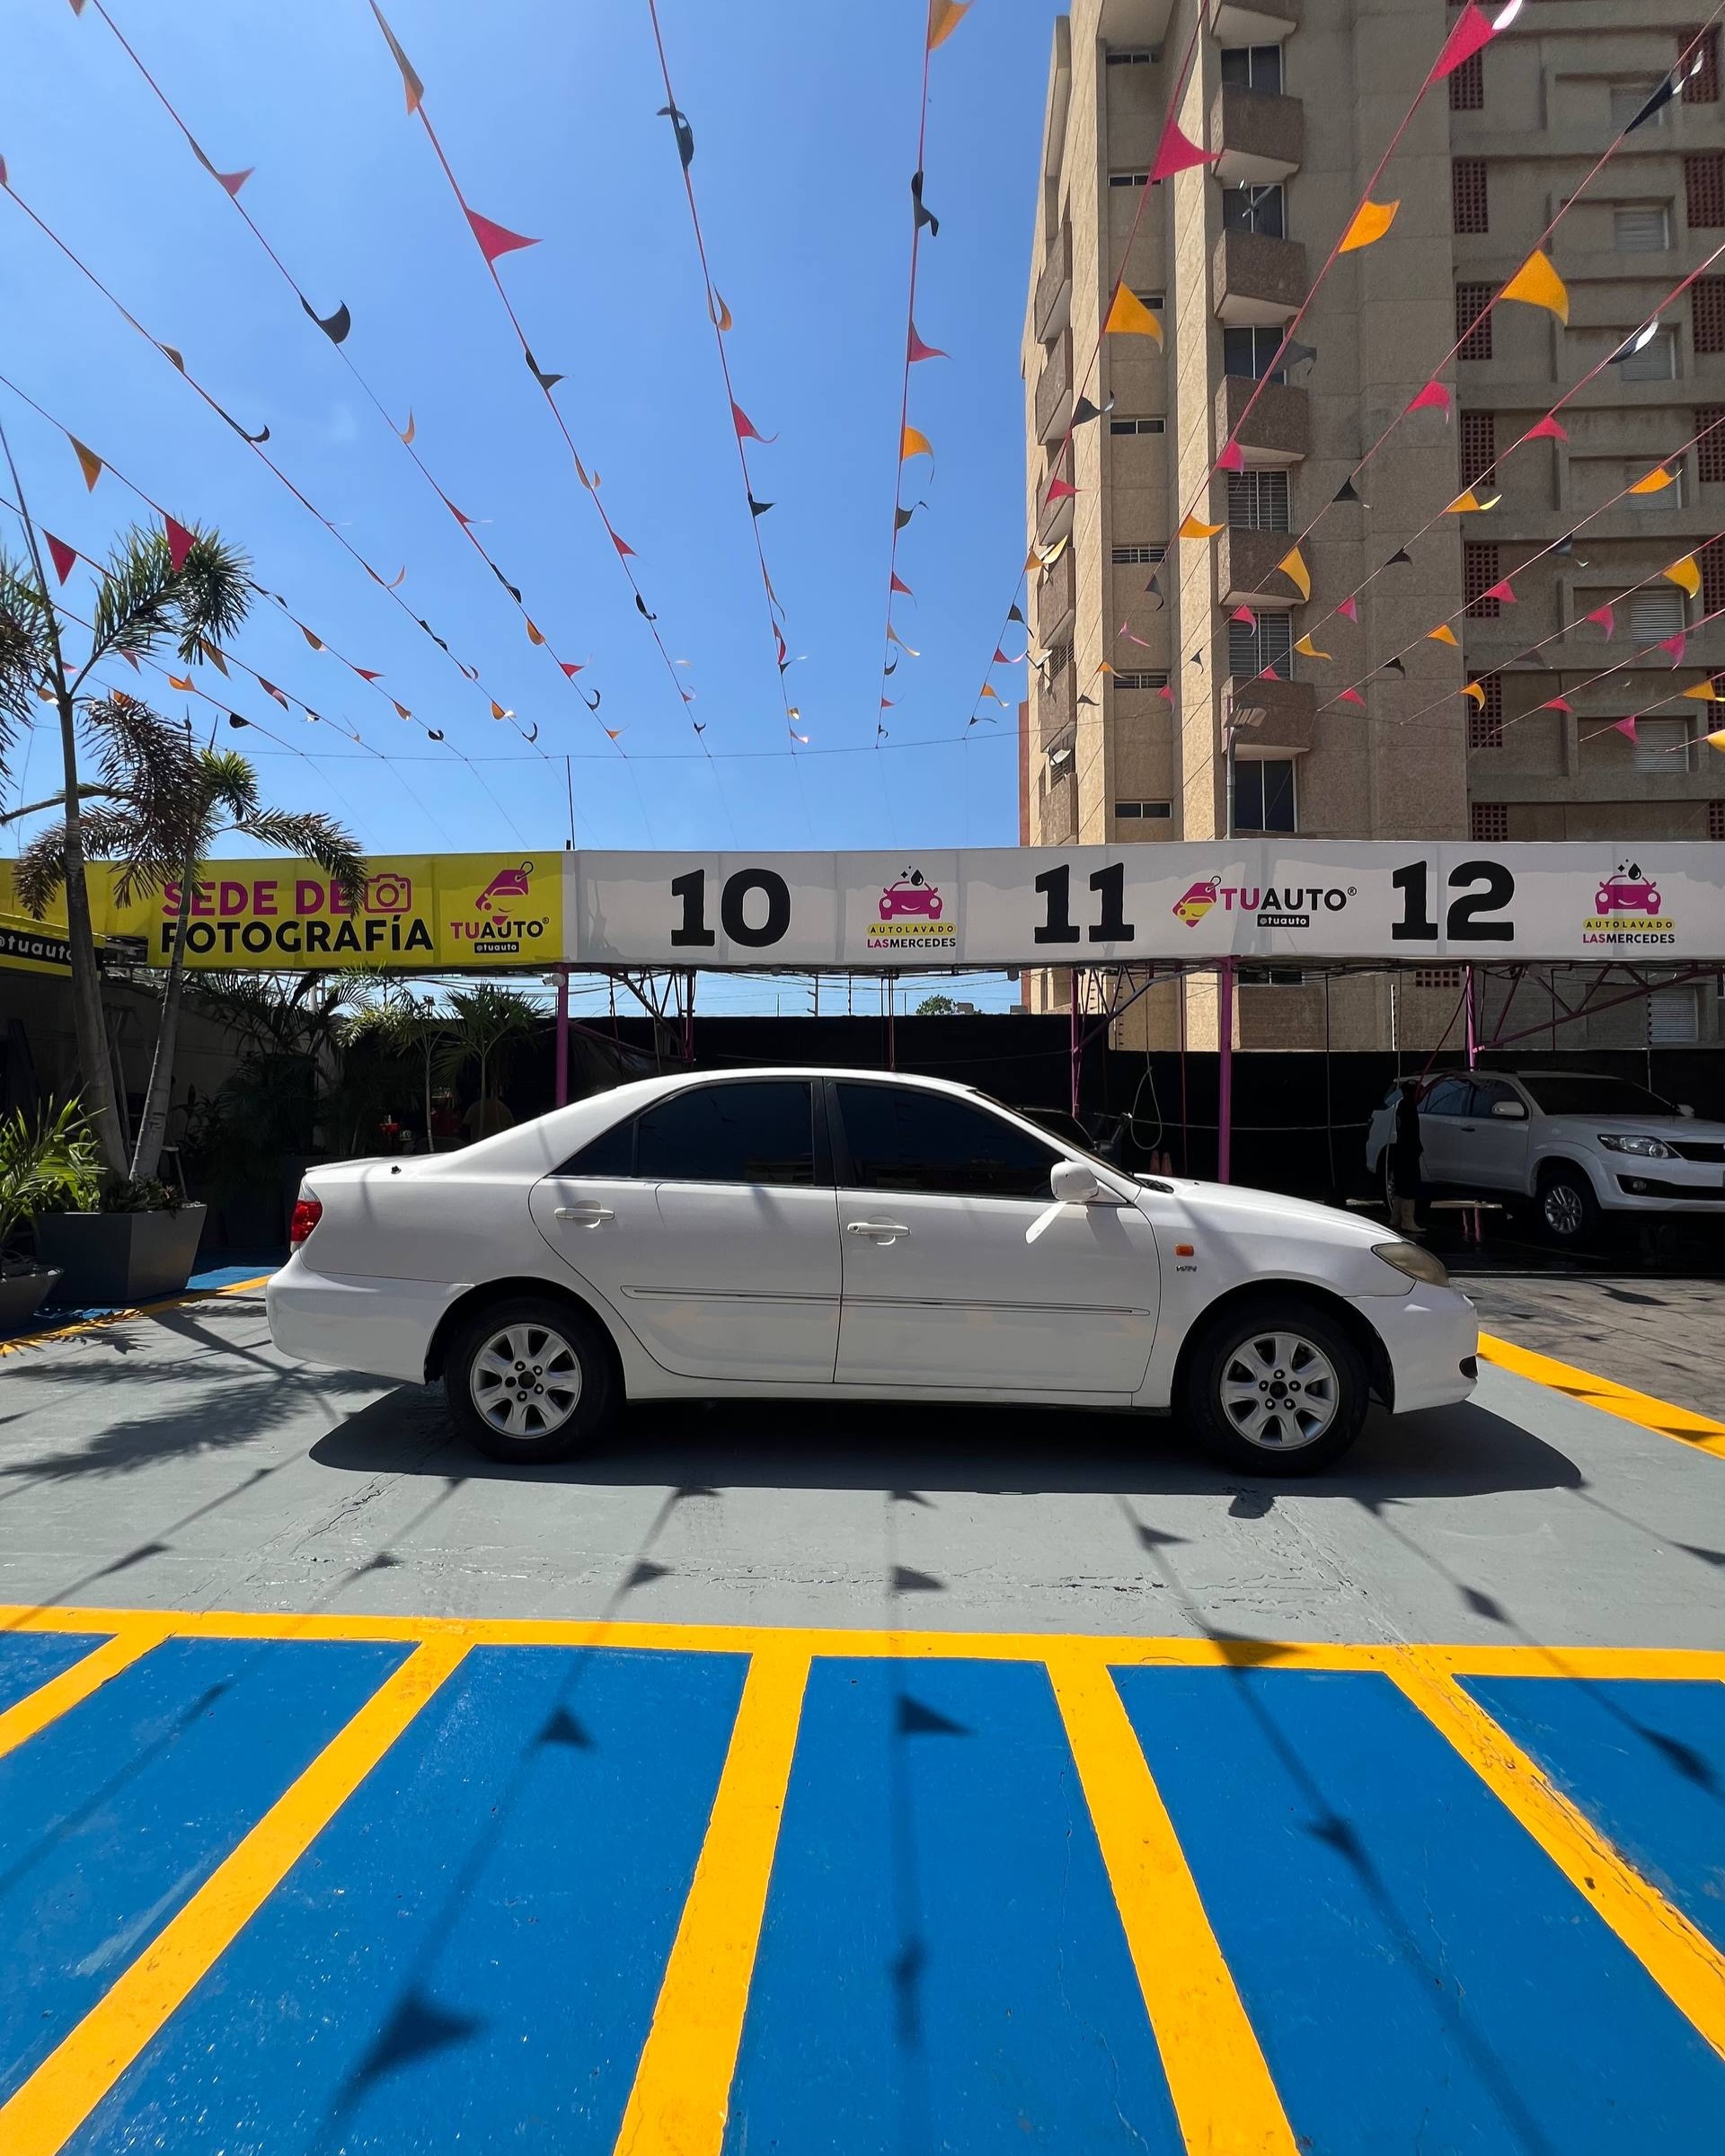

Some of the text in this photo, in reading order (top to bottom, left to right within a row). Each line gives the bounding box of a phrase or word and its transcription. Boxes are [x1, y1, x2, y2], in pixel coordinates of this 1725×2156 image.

[162, 881, 278, 916] SEDE
[671, 869, 791, 948] 10
[1035, 862, 1135, 944] 11
[1392, 860, 1516, 941] 12
[161, 914, 434, 954] FOTOGRAFÍA
[871, 925, 954, 933] AUTOLAVADO
[1586, 921, 1673, 929] AUTOLAVADO
